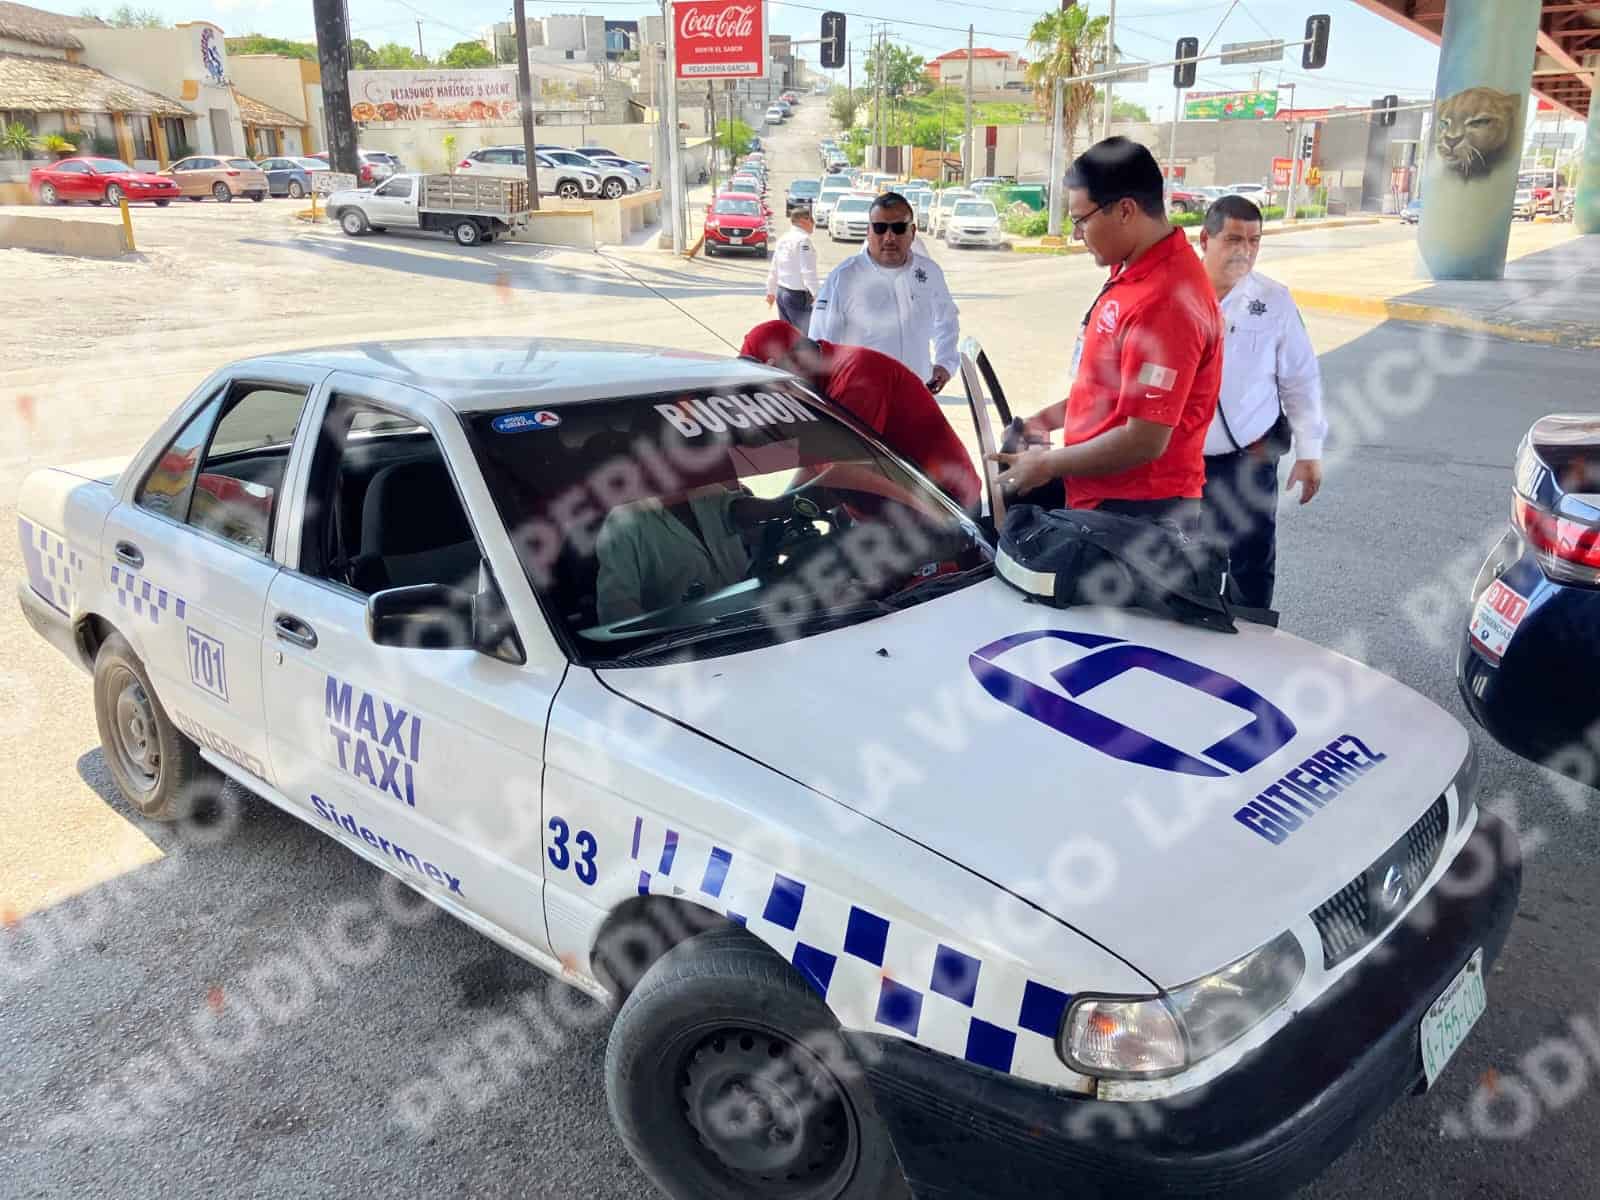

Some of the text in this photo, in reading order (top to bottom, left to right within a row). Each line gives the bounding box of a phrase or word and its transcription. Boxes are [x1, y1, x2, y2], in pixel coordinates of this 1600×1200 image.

[681, 5, 756, 39] Coca-Cola
[653, 391, 819, 438] BUCHON
[189, 635, 224, 694] 701
[326, 675, 421, 764] MAXI
[330, 724, 416, 808] TAXI
[1233, 734, 1388, 846] GUTIERREZ
[310, 794, 466, 898] Sidermex
[547, 815, 598, 886] 33
